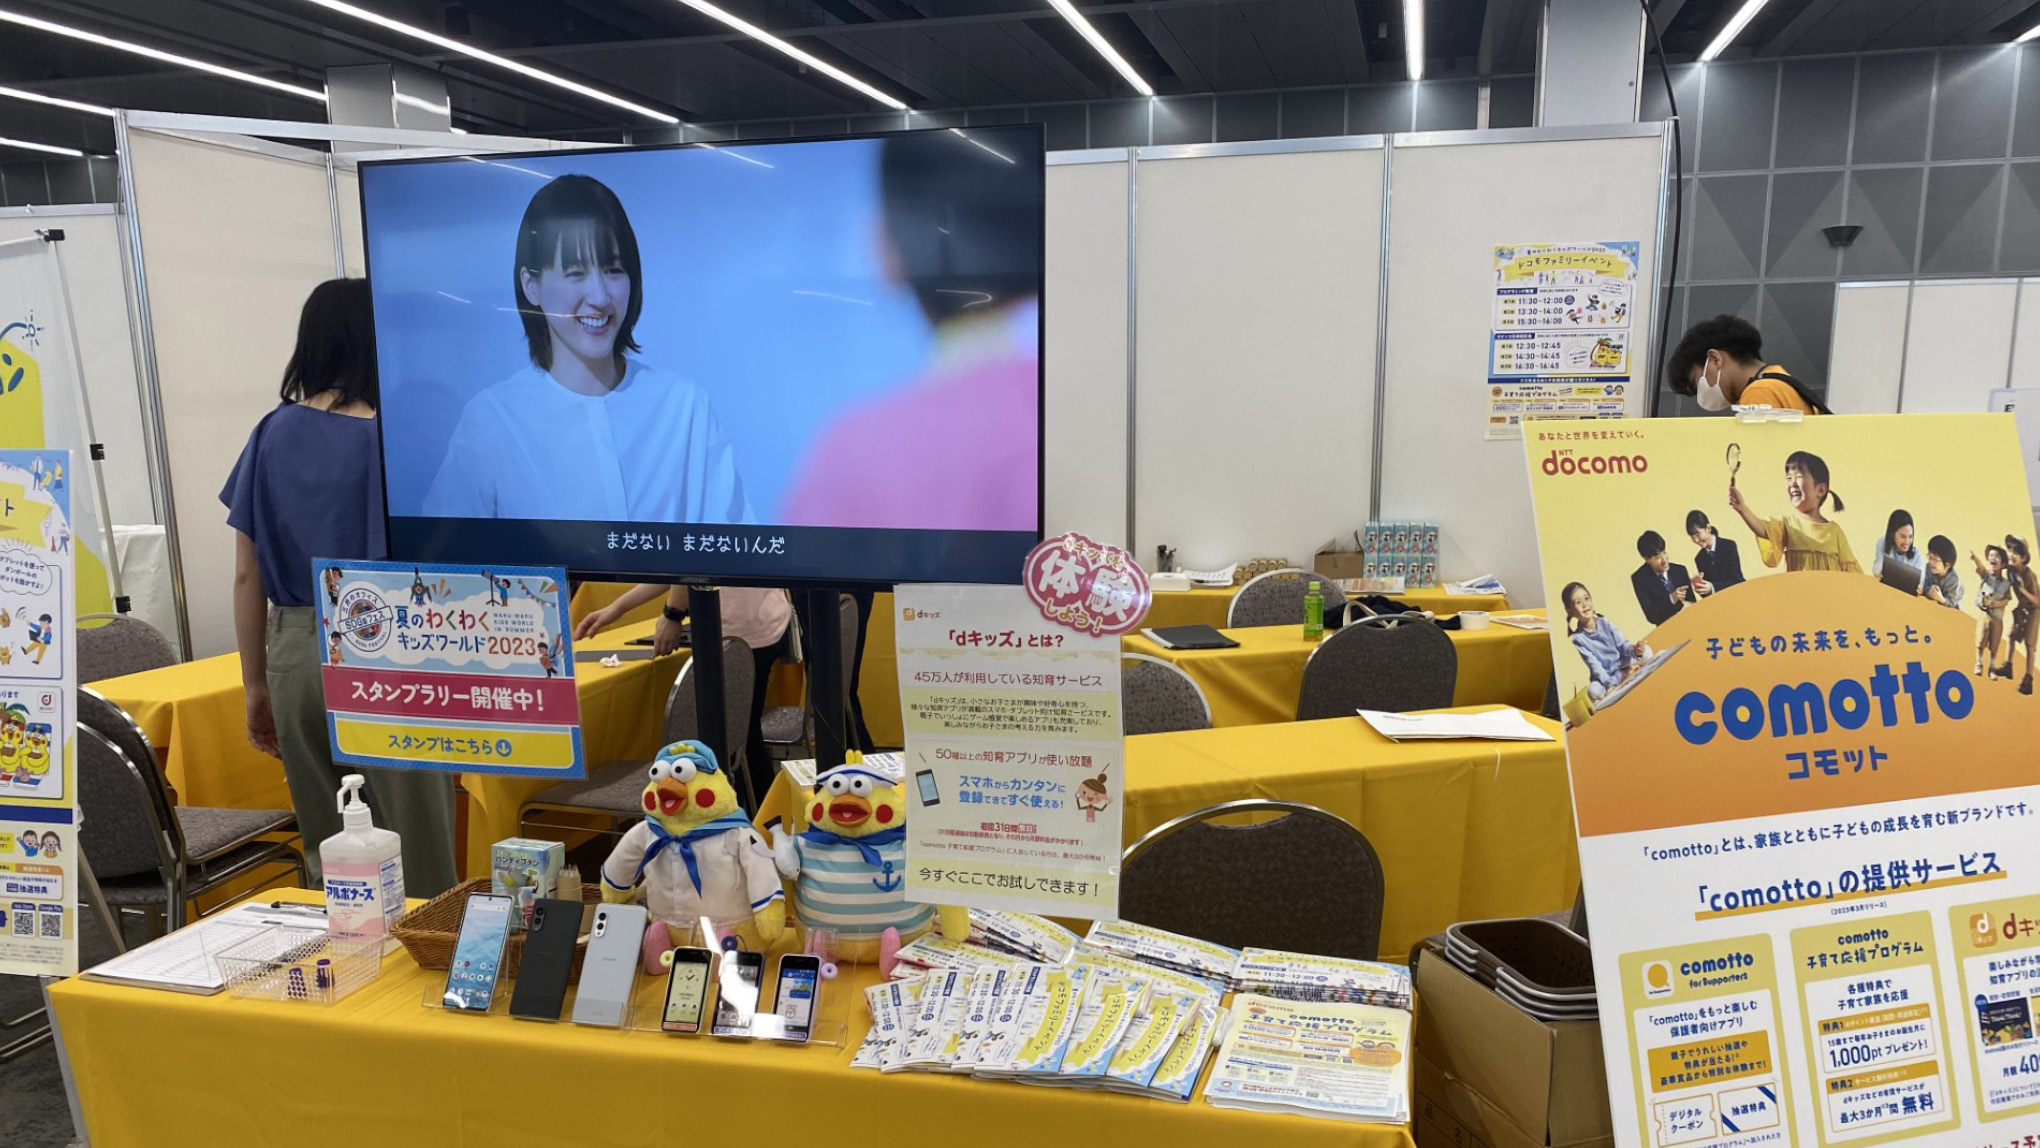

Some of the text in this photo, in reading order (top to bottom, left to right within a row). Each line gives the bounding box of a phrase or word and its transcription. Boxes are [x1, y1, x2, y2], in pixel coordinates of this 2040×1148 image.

[1518, 256, 1613, 269] ドコモファミリーイベント
[1538, 430, 1645, 441] あなたと世界を変えていく。
[1542, 450, 1648, 476] docomo
[607, 532, 785, 555] まだない まだないんだ
[1039, 550, 1137, 622] 体験
[394, 605, 490, 633] 夏のわくわく
[917, 609, 941, 620] dキッズ
[1045, 597, 1104, 634] しよう!
[1706, 624, 1934, 661] 子どもの未来を、もっと。
[914, 672, 1103, 687] 45万人が利用している知育サービス
[351, 681, 545, 712] スタンプラリー開催中!
[1674, 661, 1975, 745] comotto
[388, 735, 494, 755] スタンプはこちら
[935, 748, 1093, 769] 50種以上の知育アプリが使い放題
[1785, 745, 1889, 780] コモット
[959, 775, 1066, 794] スマホからカンタンに
[959, 790, 1064, 810] 登録できてすぐ使える!
[1643, 802, 2034, 862] 「comotto」とは、家族とともに子どもの成長を育む新ブランドです。
[919, 867, 1099, 898] 今すぐここでお試しできます!
[1698, 851, 2002, 912] 「comotto」の提供サービス
[326, 885, 375, 901] アルボナース
[1837, 928, 1890, 946] comotto
[1680, 952, 1754, 976] comotto
[1807, 943, 1925, 970] 子育て応援プログラム
[1689, 972, 1749, 989] for Supporters
[1847, 979, 1893, 995] 各種特典で
[1837, 989, 1910, 1010] 子育て家族を応援
[1033, 981, 1067, 1052] ドコモファミリーイベント
[1289, 1014, 1355, 1025] comotto
[1649, 1000, 1758, 1026] 「comotto」をもっと楽しむ
[1082, 997, 1121, 1055] コモファミリーイベント
[1128, 1005, 1170, 1063] ドコモファミリーイベント
[1670, 1016, 1744, 1038] 保護者向けアプリ
[1671, 1040, 1749, 1060] 親子でうれしい抽選や
[1829, 1039, 1928, 1068] 1,000pt プレゼント!
[2019, 1053, 2040, 1075] 40
[1731, 1101, 1768, 1117] 抽選特典
[1902, 1092, 1934, 1115] 無料
[1669, 1108, 1703, 1122] デジタル
[1671, 1120, 1705, 1135] クーポン
